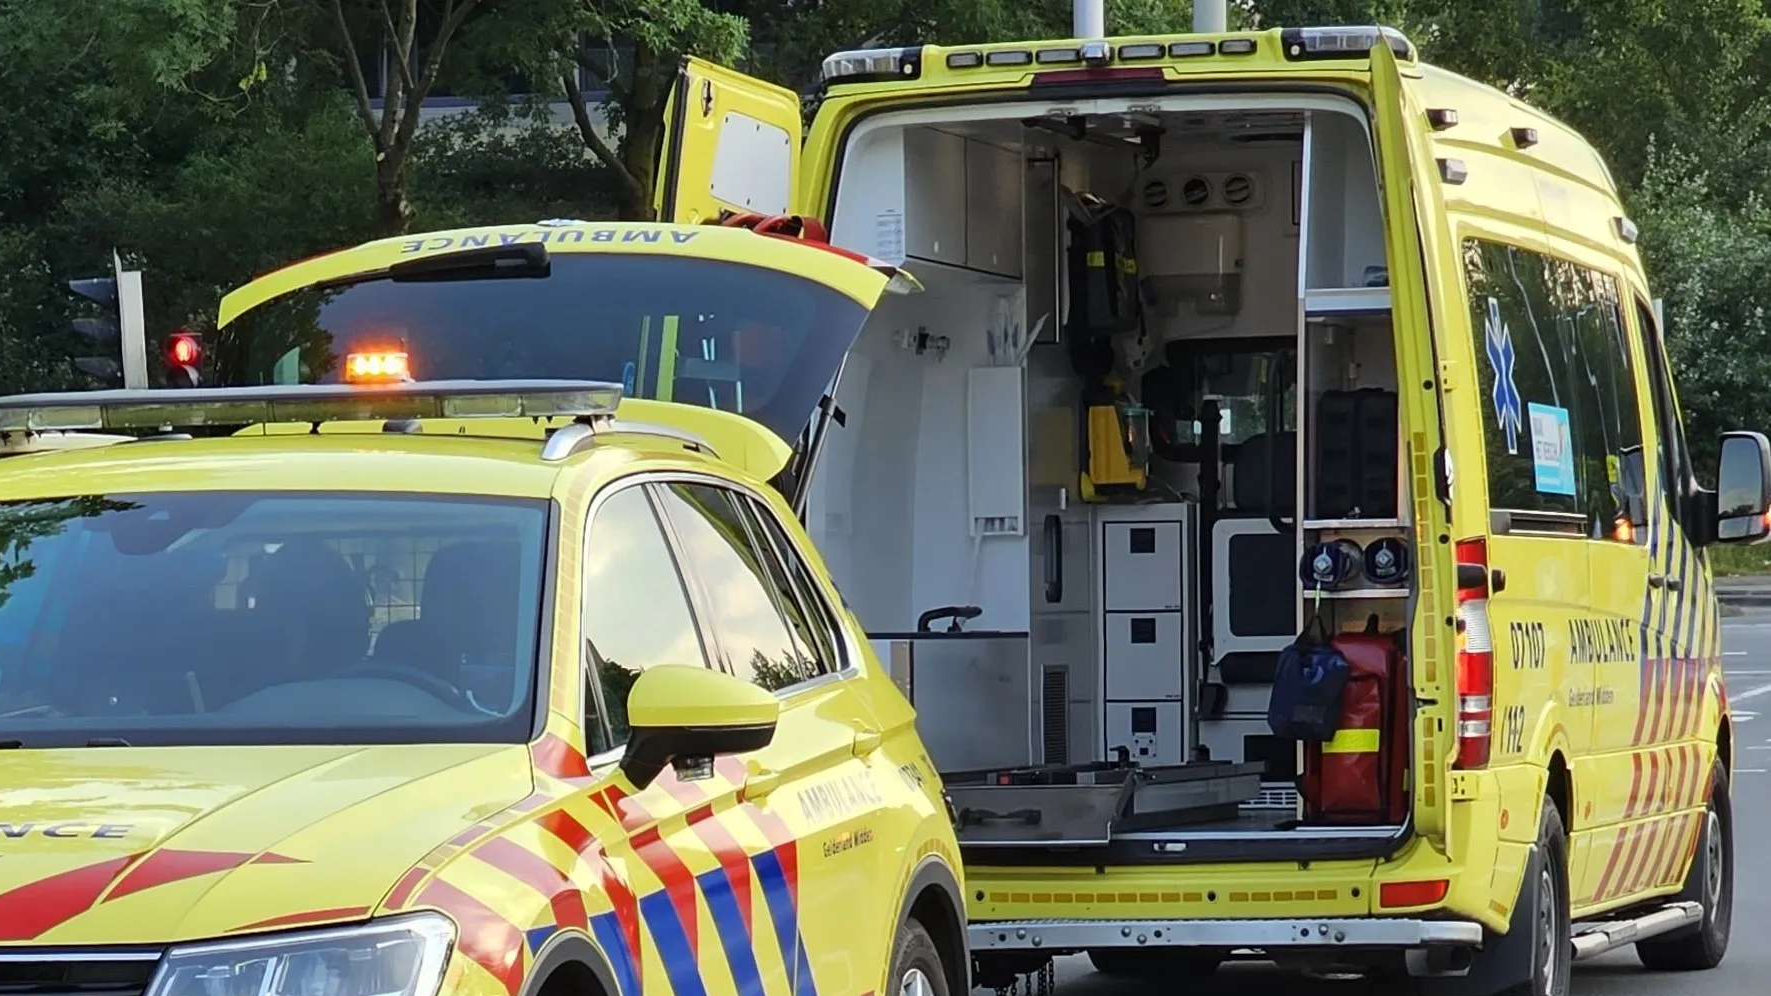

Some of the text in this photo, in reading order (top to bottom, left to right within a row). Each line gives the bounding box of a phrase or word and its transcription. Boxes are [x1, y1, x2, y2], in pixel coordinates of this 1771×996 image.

[400, 227, 701, 254] AMBULANCE
[1510, 621, 1545, 669] 07107
[1569, 618, 1635, 665] AMBULANCE
[796, 769, 884, 830] AMBULANCE
